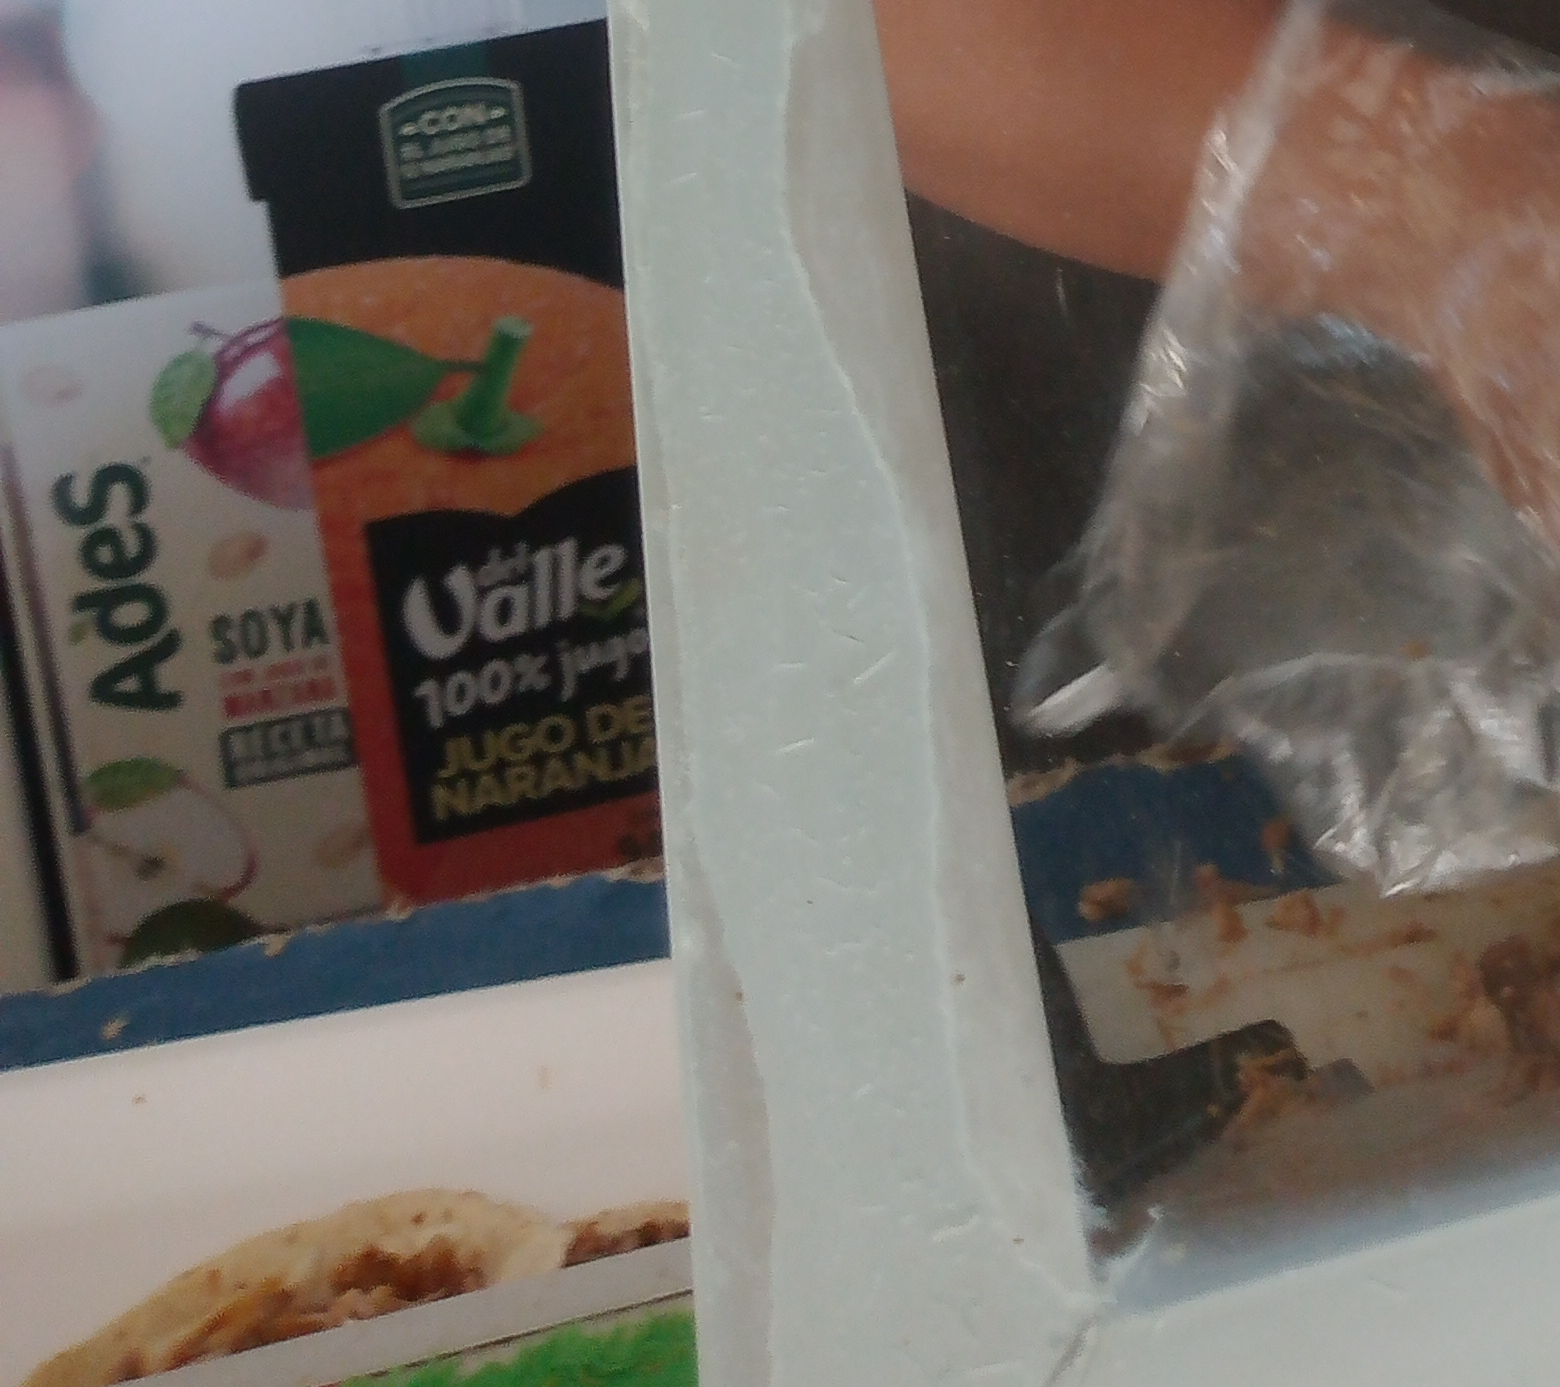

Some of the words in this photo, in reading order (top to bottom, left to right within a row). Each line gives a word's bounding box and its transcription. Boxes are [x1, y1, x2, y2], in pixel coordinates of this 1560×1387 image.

[209, 597, 330, 665] SOYA
[401, 536, 628, 660] Valle
[412, 653, 551, 729] 100%
[555, 626, 649, 702] jugo
[437, 714, 577, 777] JUGO
[585, 694, 652, 744] DE
